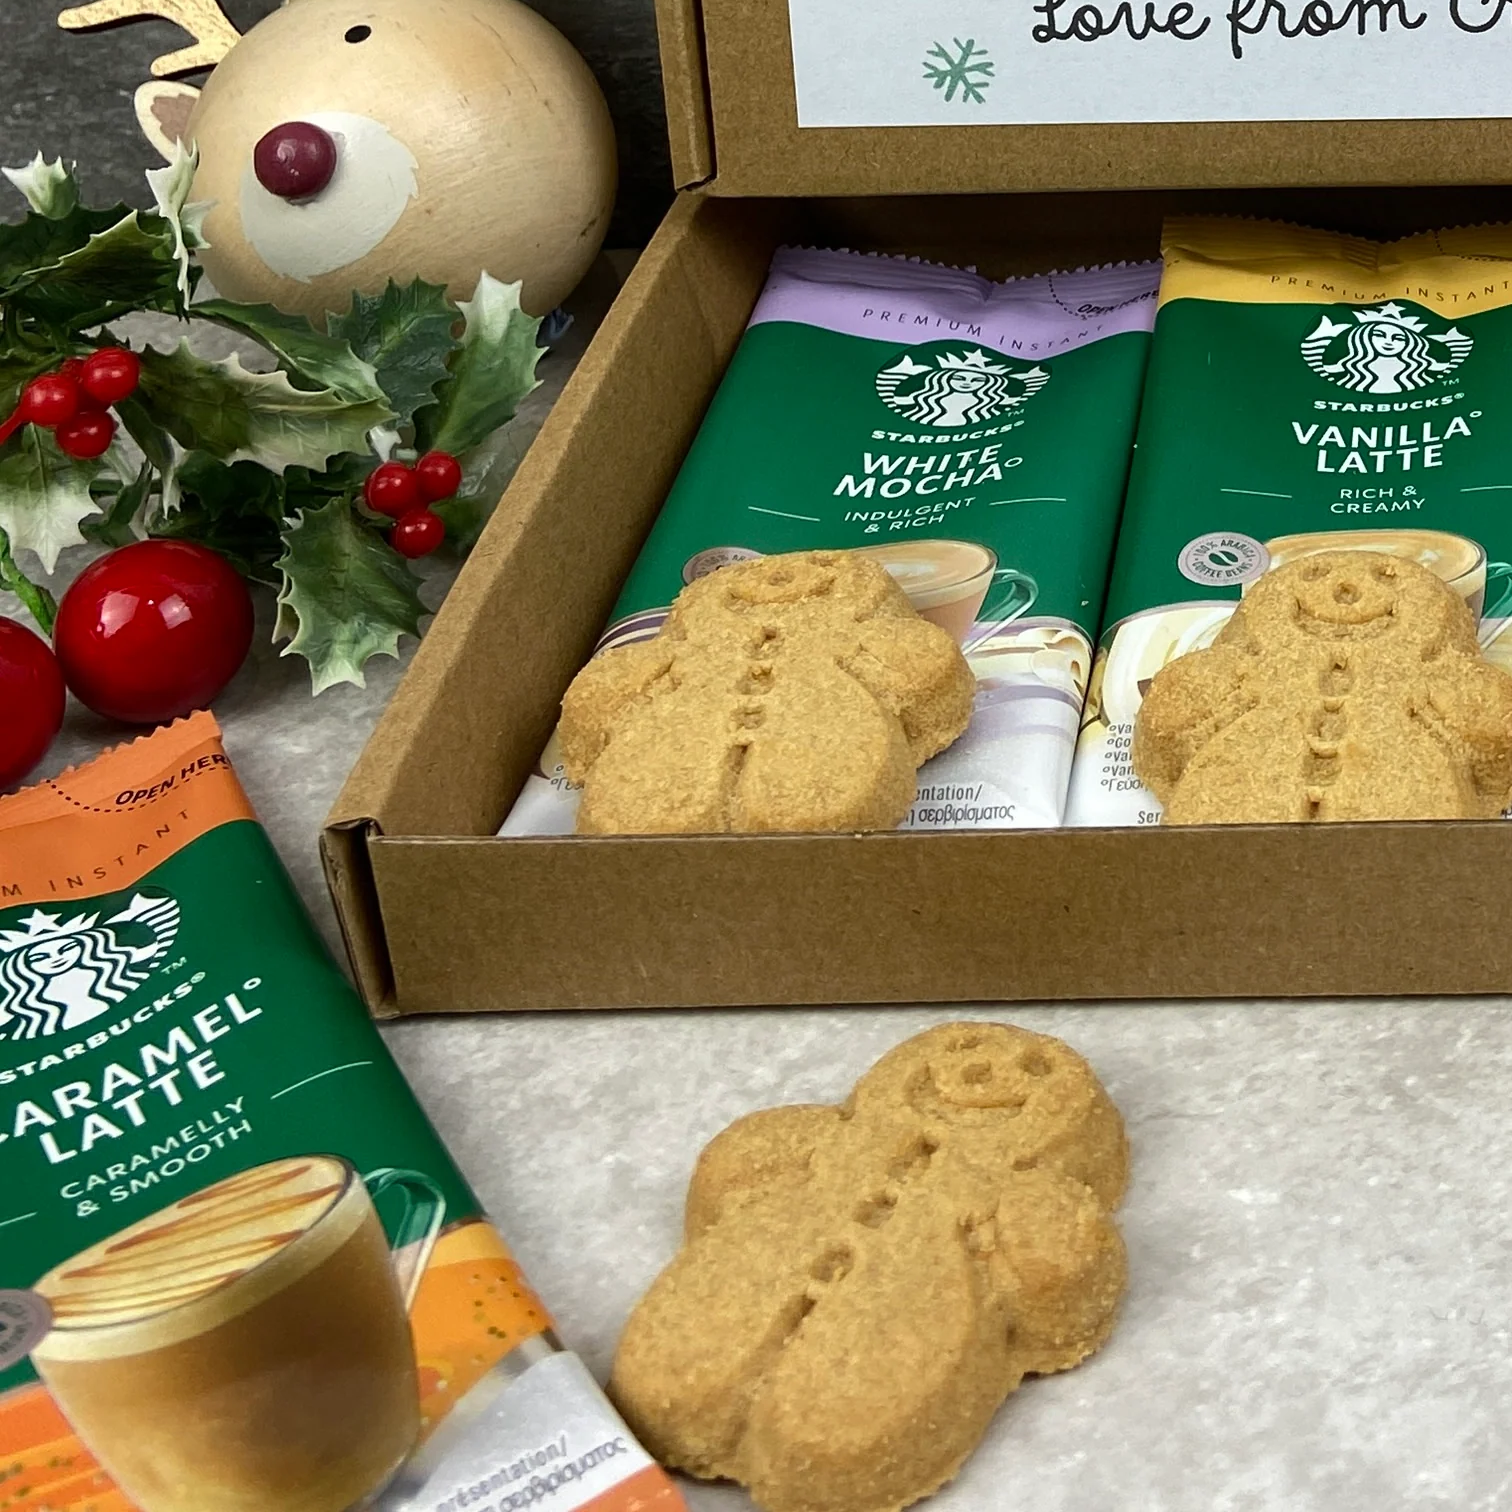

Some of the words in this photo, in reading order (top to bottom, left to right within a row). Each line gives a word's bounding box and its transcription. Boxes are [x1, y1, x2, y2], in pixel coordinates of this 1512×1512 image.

[1270, 274, 1389, 300] PREMIUM
[1405, 279, 1511, 304] INSTANT
[862, 307, 983, 338] PREMIUM
[999, 324, 1104, 352] INSTANT
[861, 443, 1004, 477] WHITE
[1316, 443, 1445, 475] LATTE
[1329, 498, 1425, 515] CREAMY
[1339, 487, 1394, 500] RICH
[1401, 485, 1418, 497] &
[843, 496, 978, 522] INDULGENT
[863, 522, 881, 533] &
[888, 513, 946, 532] RICH
[115, 775, 176, 806] OPEN
[1137, 810, 1160, 824] Ser
[49, 809, 190, 892] INSTANT
[160, 956, 188, 976] TM
[39, 1048, 226, 1165] LATTE
[60, 1096, 245, 1199] CARAMELLY
[76, 1199, 101, 1217] &
[109, 1119, 252, 1203] SMOOTH
